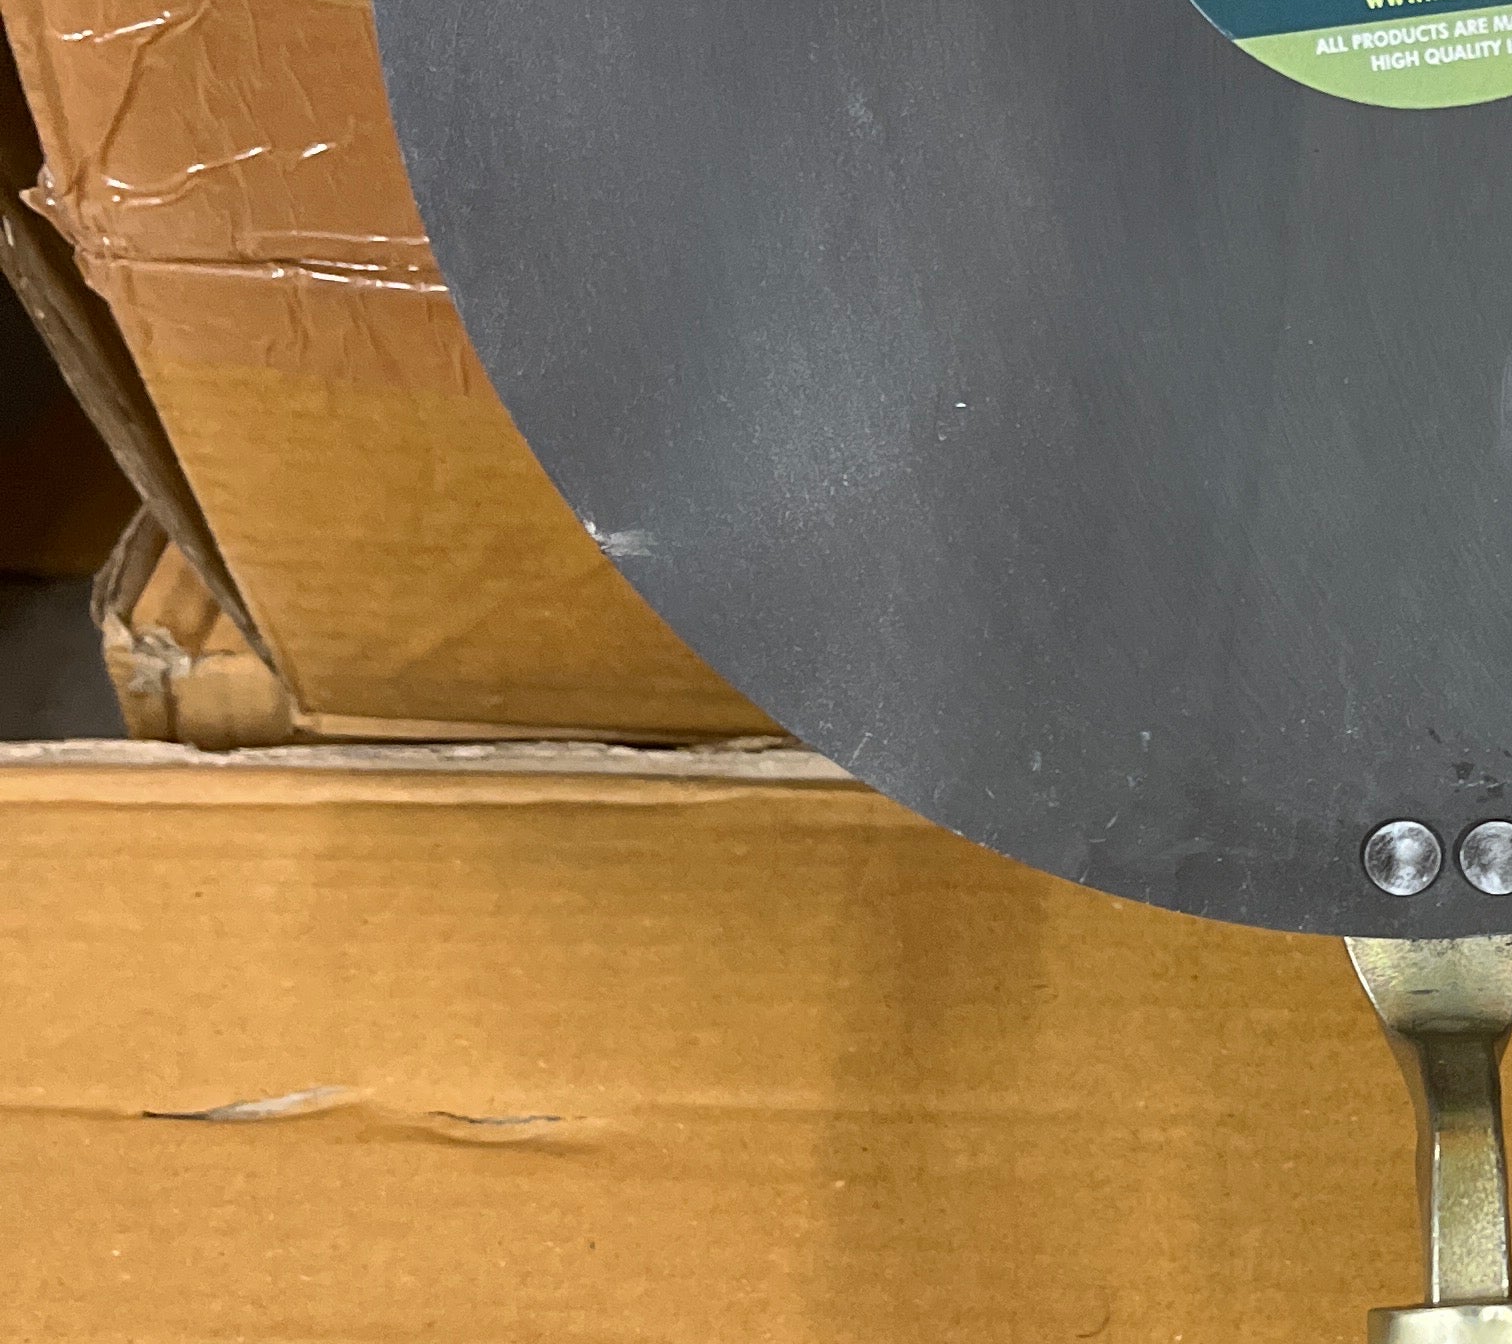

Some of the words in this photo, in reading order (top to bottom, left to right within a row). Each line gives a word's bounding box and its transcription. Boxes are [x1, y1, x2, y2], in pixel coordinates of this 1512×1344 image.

[1315, 36, 1348, 56] ALL
[1352, 21, 1449, 51] PRODUCTS
[1454, 16, 1489, 37] ARE
[1370, 52, 1420, 72] HIGH
[1424, 39, 1502, 66] QUALITY
